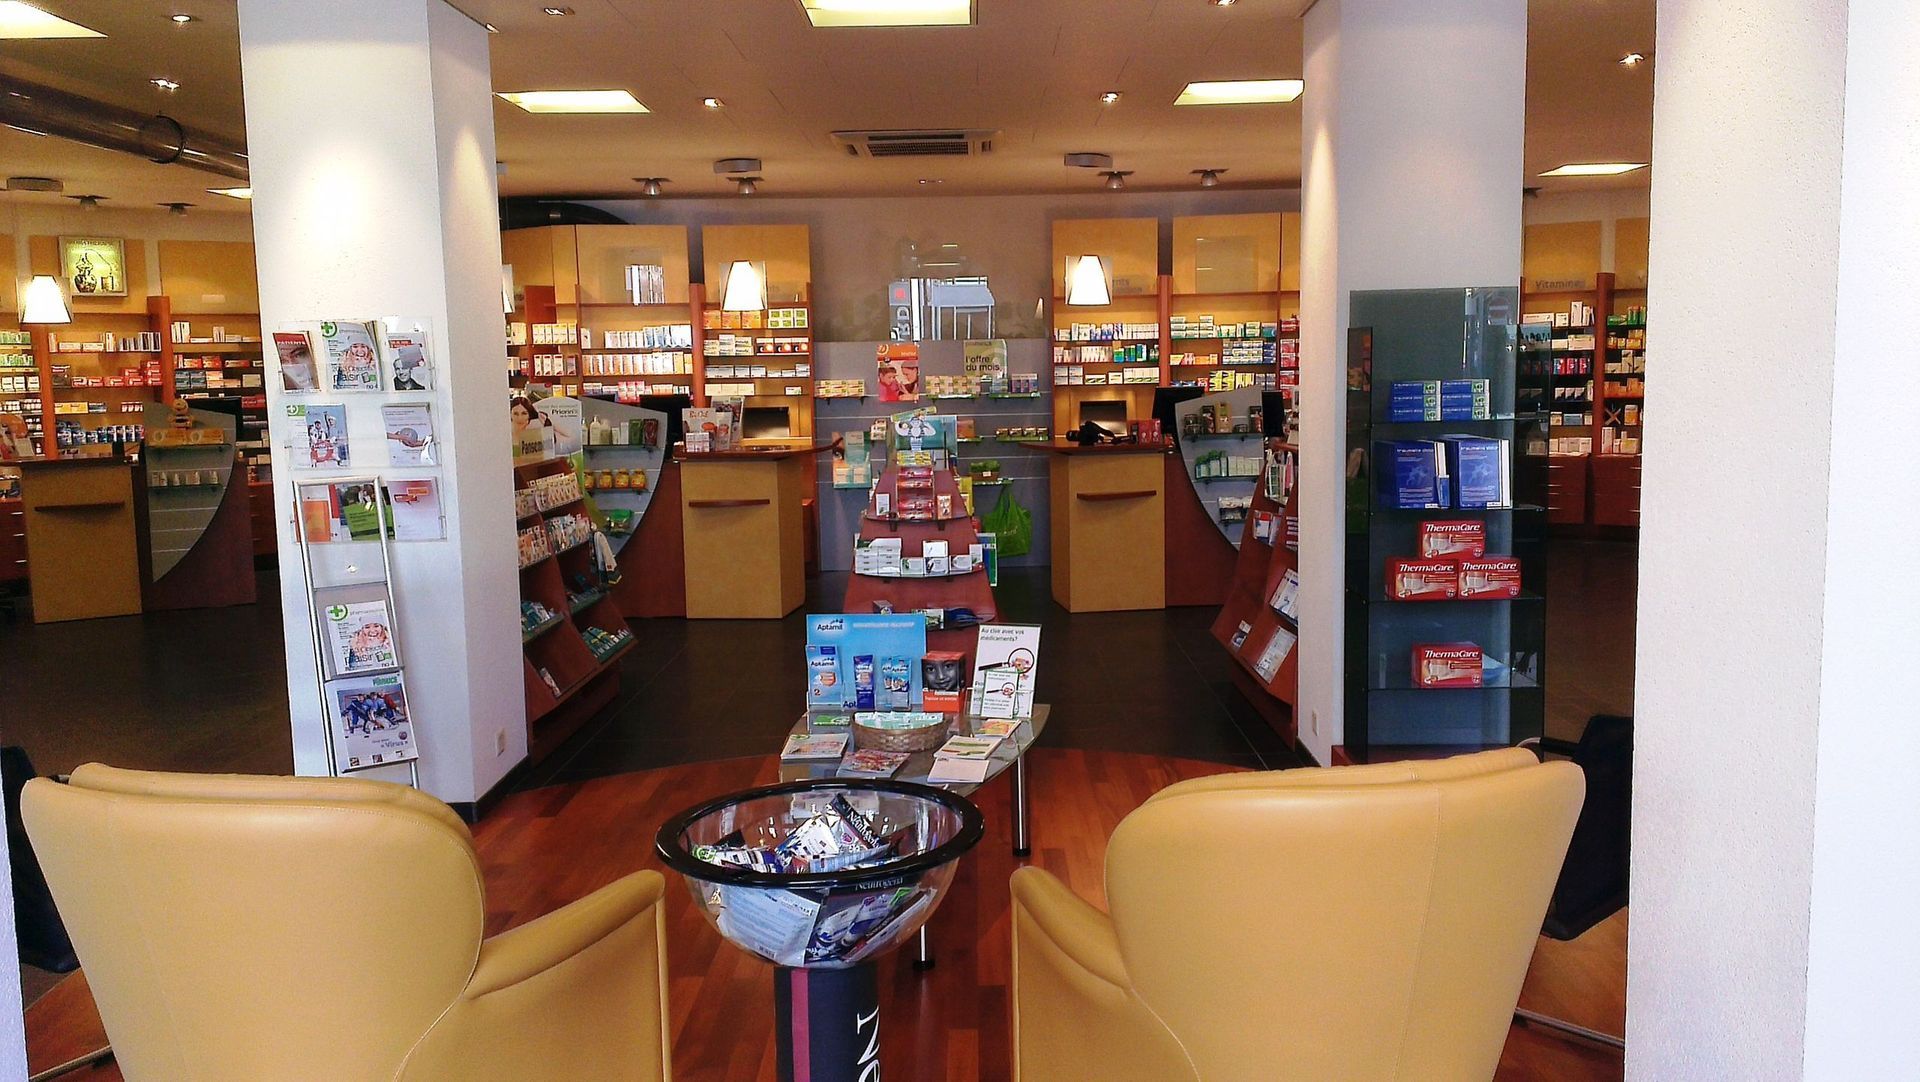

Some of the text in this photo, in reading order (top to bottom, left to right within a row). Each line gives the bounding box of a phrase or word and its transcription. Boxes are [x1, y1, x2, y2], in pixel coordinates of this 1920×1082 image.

[965, 355, 990, 363] l'offre
[966, 363, 978, 371] du
[1425, 523, 1481, 533] ThermaCare
[1399, 563, 1454, 573] ThermaCare
[1462, 562, 1517, 572] ThermaCare
[816, 623, 843, 632] Aptamil
[1424, 649, 1479, 659] ThermaCare
[813, 688, 821, 697] 2
